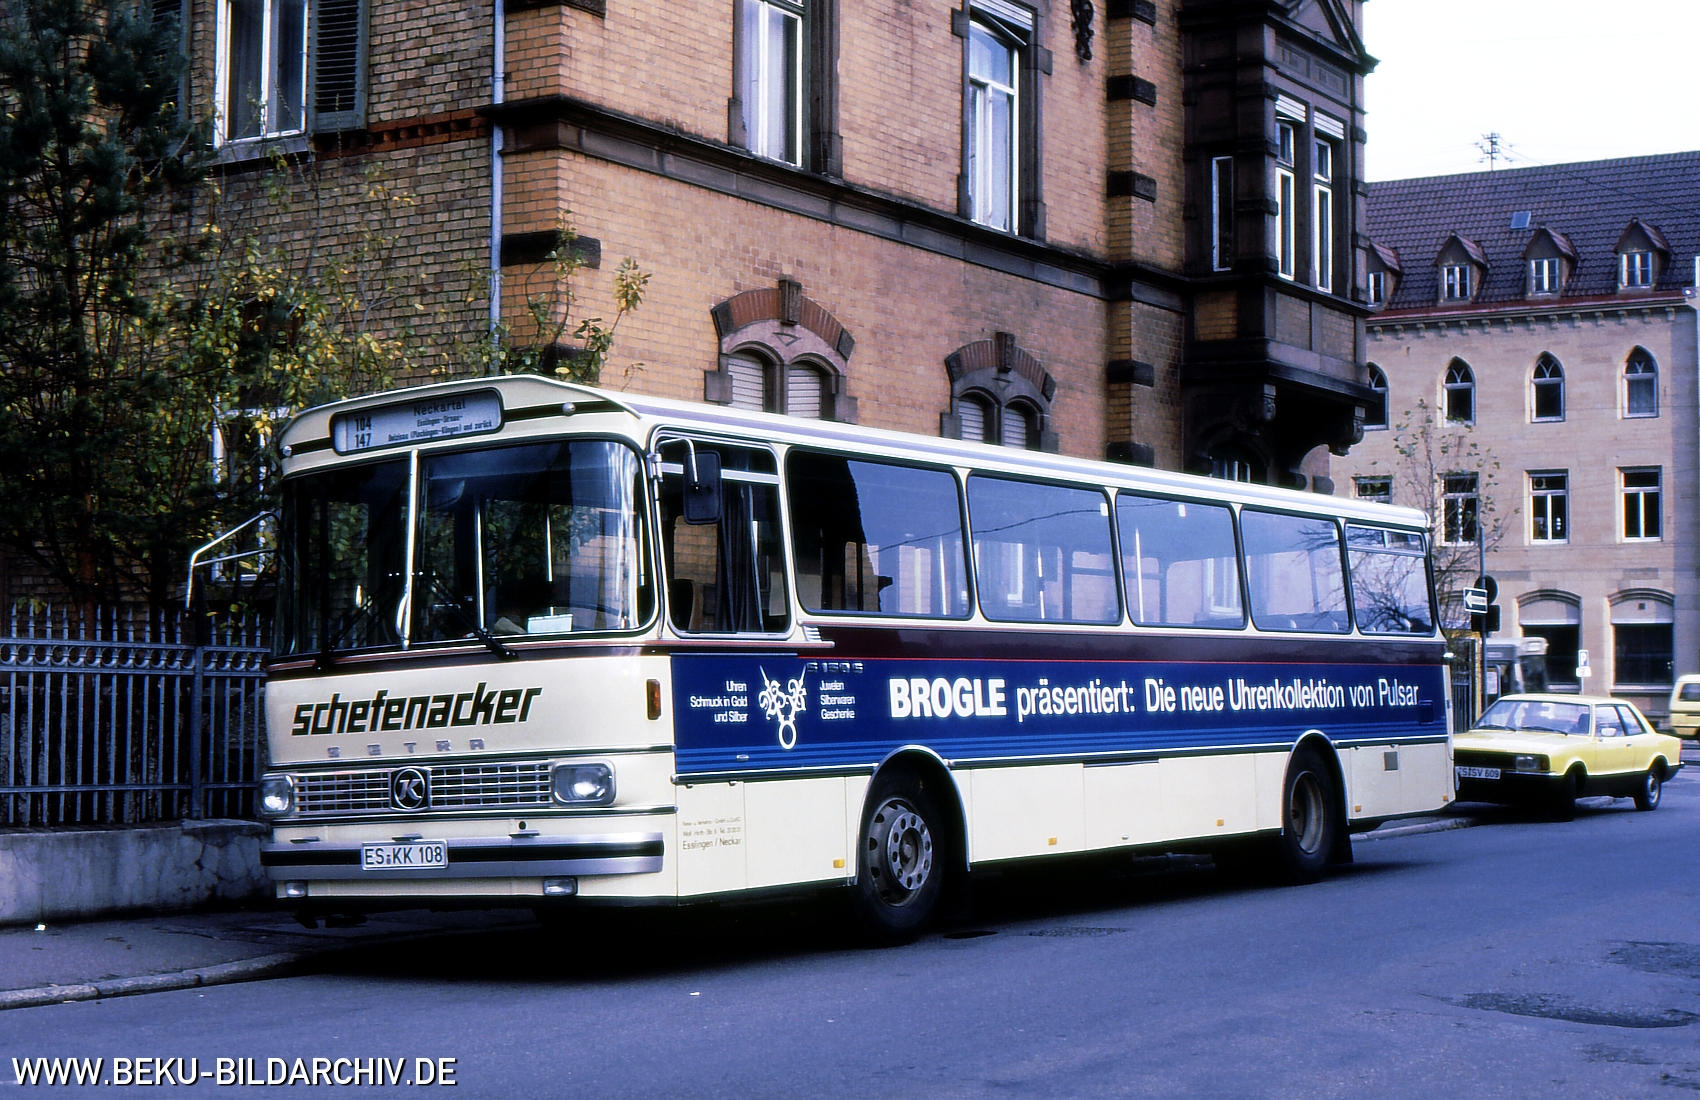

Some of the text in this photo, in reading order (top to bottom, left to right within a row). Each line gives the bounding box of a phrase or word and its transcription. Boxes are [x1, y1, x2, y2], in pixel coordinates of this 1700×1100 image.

[414, 399, 466, 417] Neckartal
[355, 416, 372, 432] 104
[464, 422, 473, 431] und
[474, 419, 493, 430] zurück
[355, 433, 372, 448] 147
[726, 680, 748, 692] Uhren
[819, 680, 844, 691] Juwelen
[690, 695, 748, 708] Schmuck in Gold
[820, 694, 855, 706] Silberwaren
[889, 678, 1419, 722] BROGLE präsentiert: Die neue Uhrenkollektion von Pulsar
[291, 682, 543, 736] schefenacker
[714, 710, 748, 722] und Silber
[820, 709, 855, 720] Geschenke
[327, 738, 485, 758] SETRA
[682, 839, 713, 851] Esslingen
[719, 837, 742, 847] Neckar
[419, 846, 443, 863] 108
